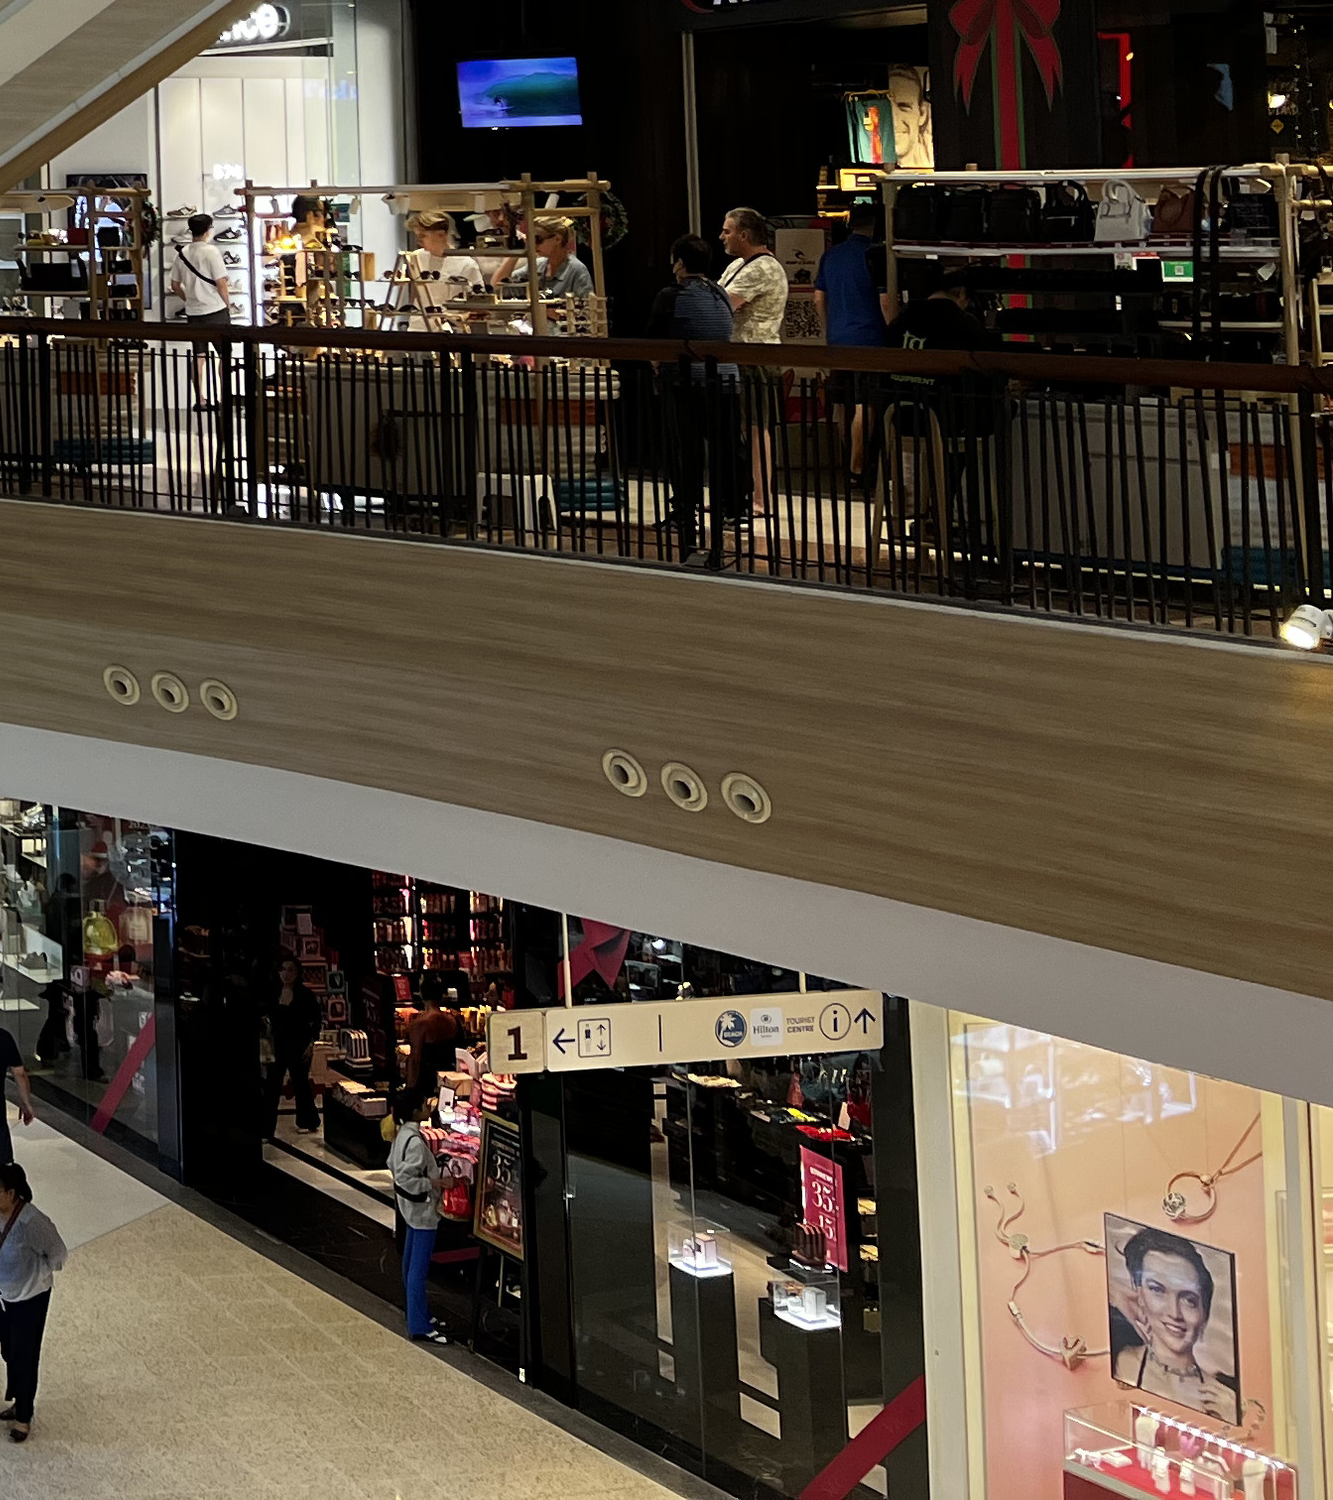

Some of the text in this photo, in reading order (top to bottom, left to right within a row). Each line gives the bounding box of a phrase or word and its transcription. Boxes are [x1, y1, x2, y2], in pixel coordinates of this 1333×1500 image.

[786, 1016, 815, 1025] TOURIST
[753, 1025, 779, 1034] Hilton
[507, 1026, 528, 1061] 1
